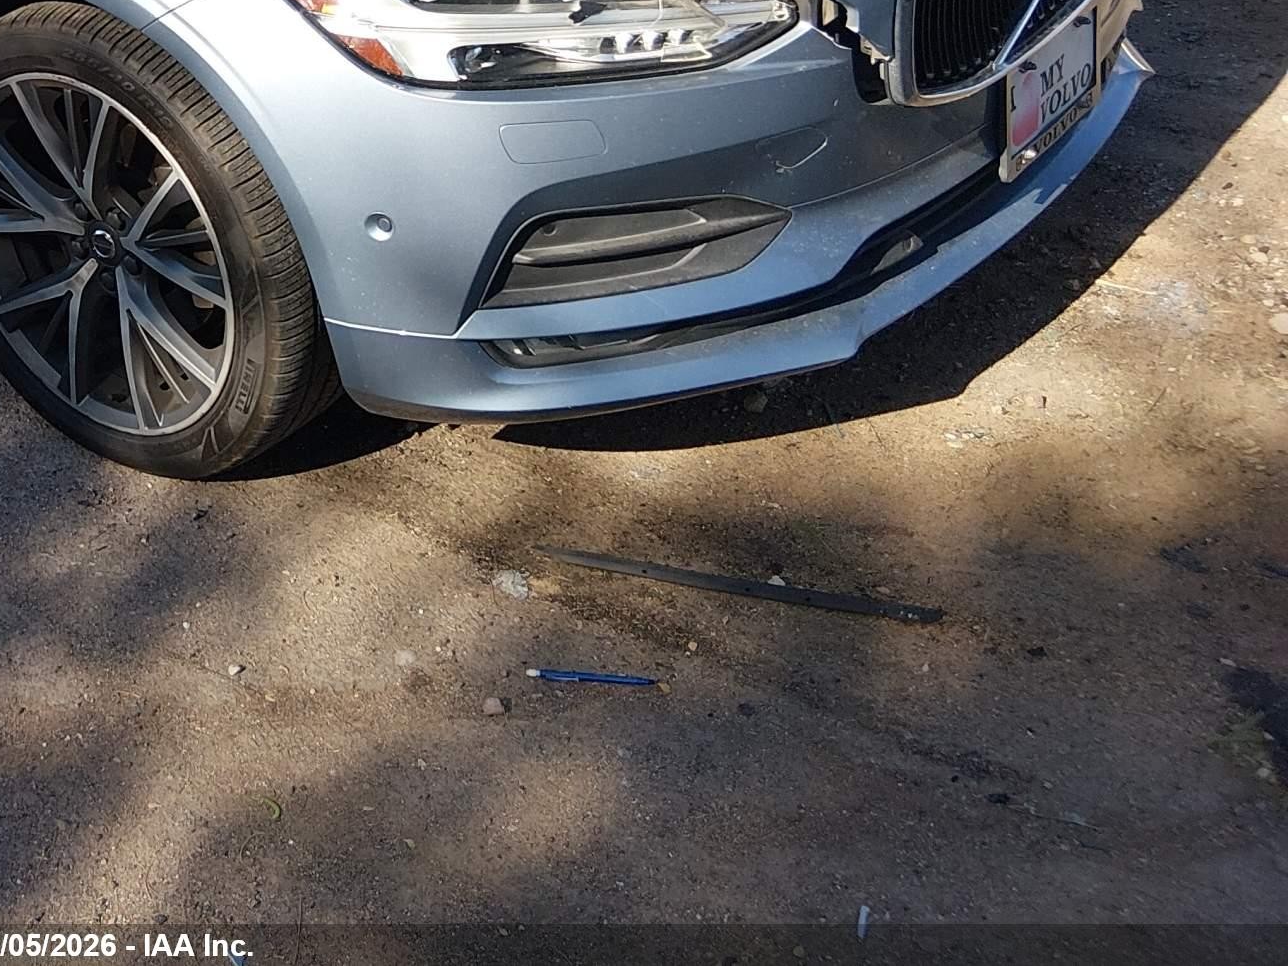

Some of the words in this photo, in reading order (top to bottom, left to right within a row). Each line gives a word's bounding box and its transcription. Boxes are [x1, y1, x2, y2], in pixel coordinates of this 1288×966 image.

[1040, 53, 1064, 97] MY
[1040, 63, 1091, 123] VOLVO
[1034, 109, 1078, 154] VOLVO
